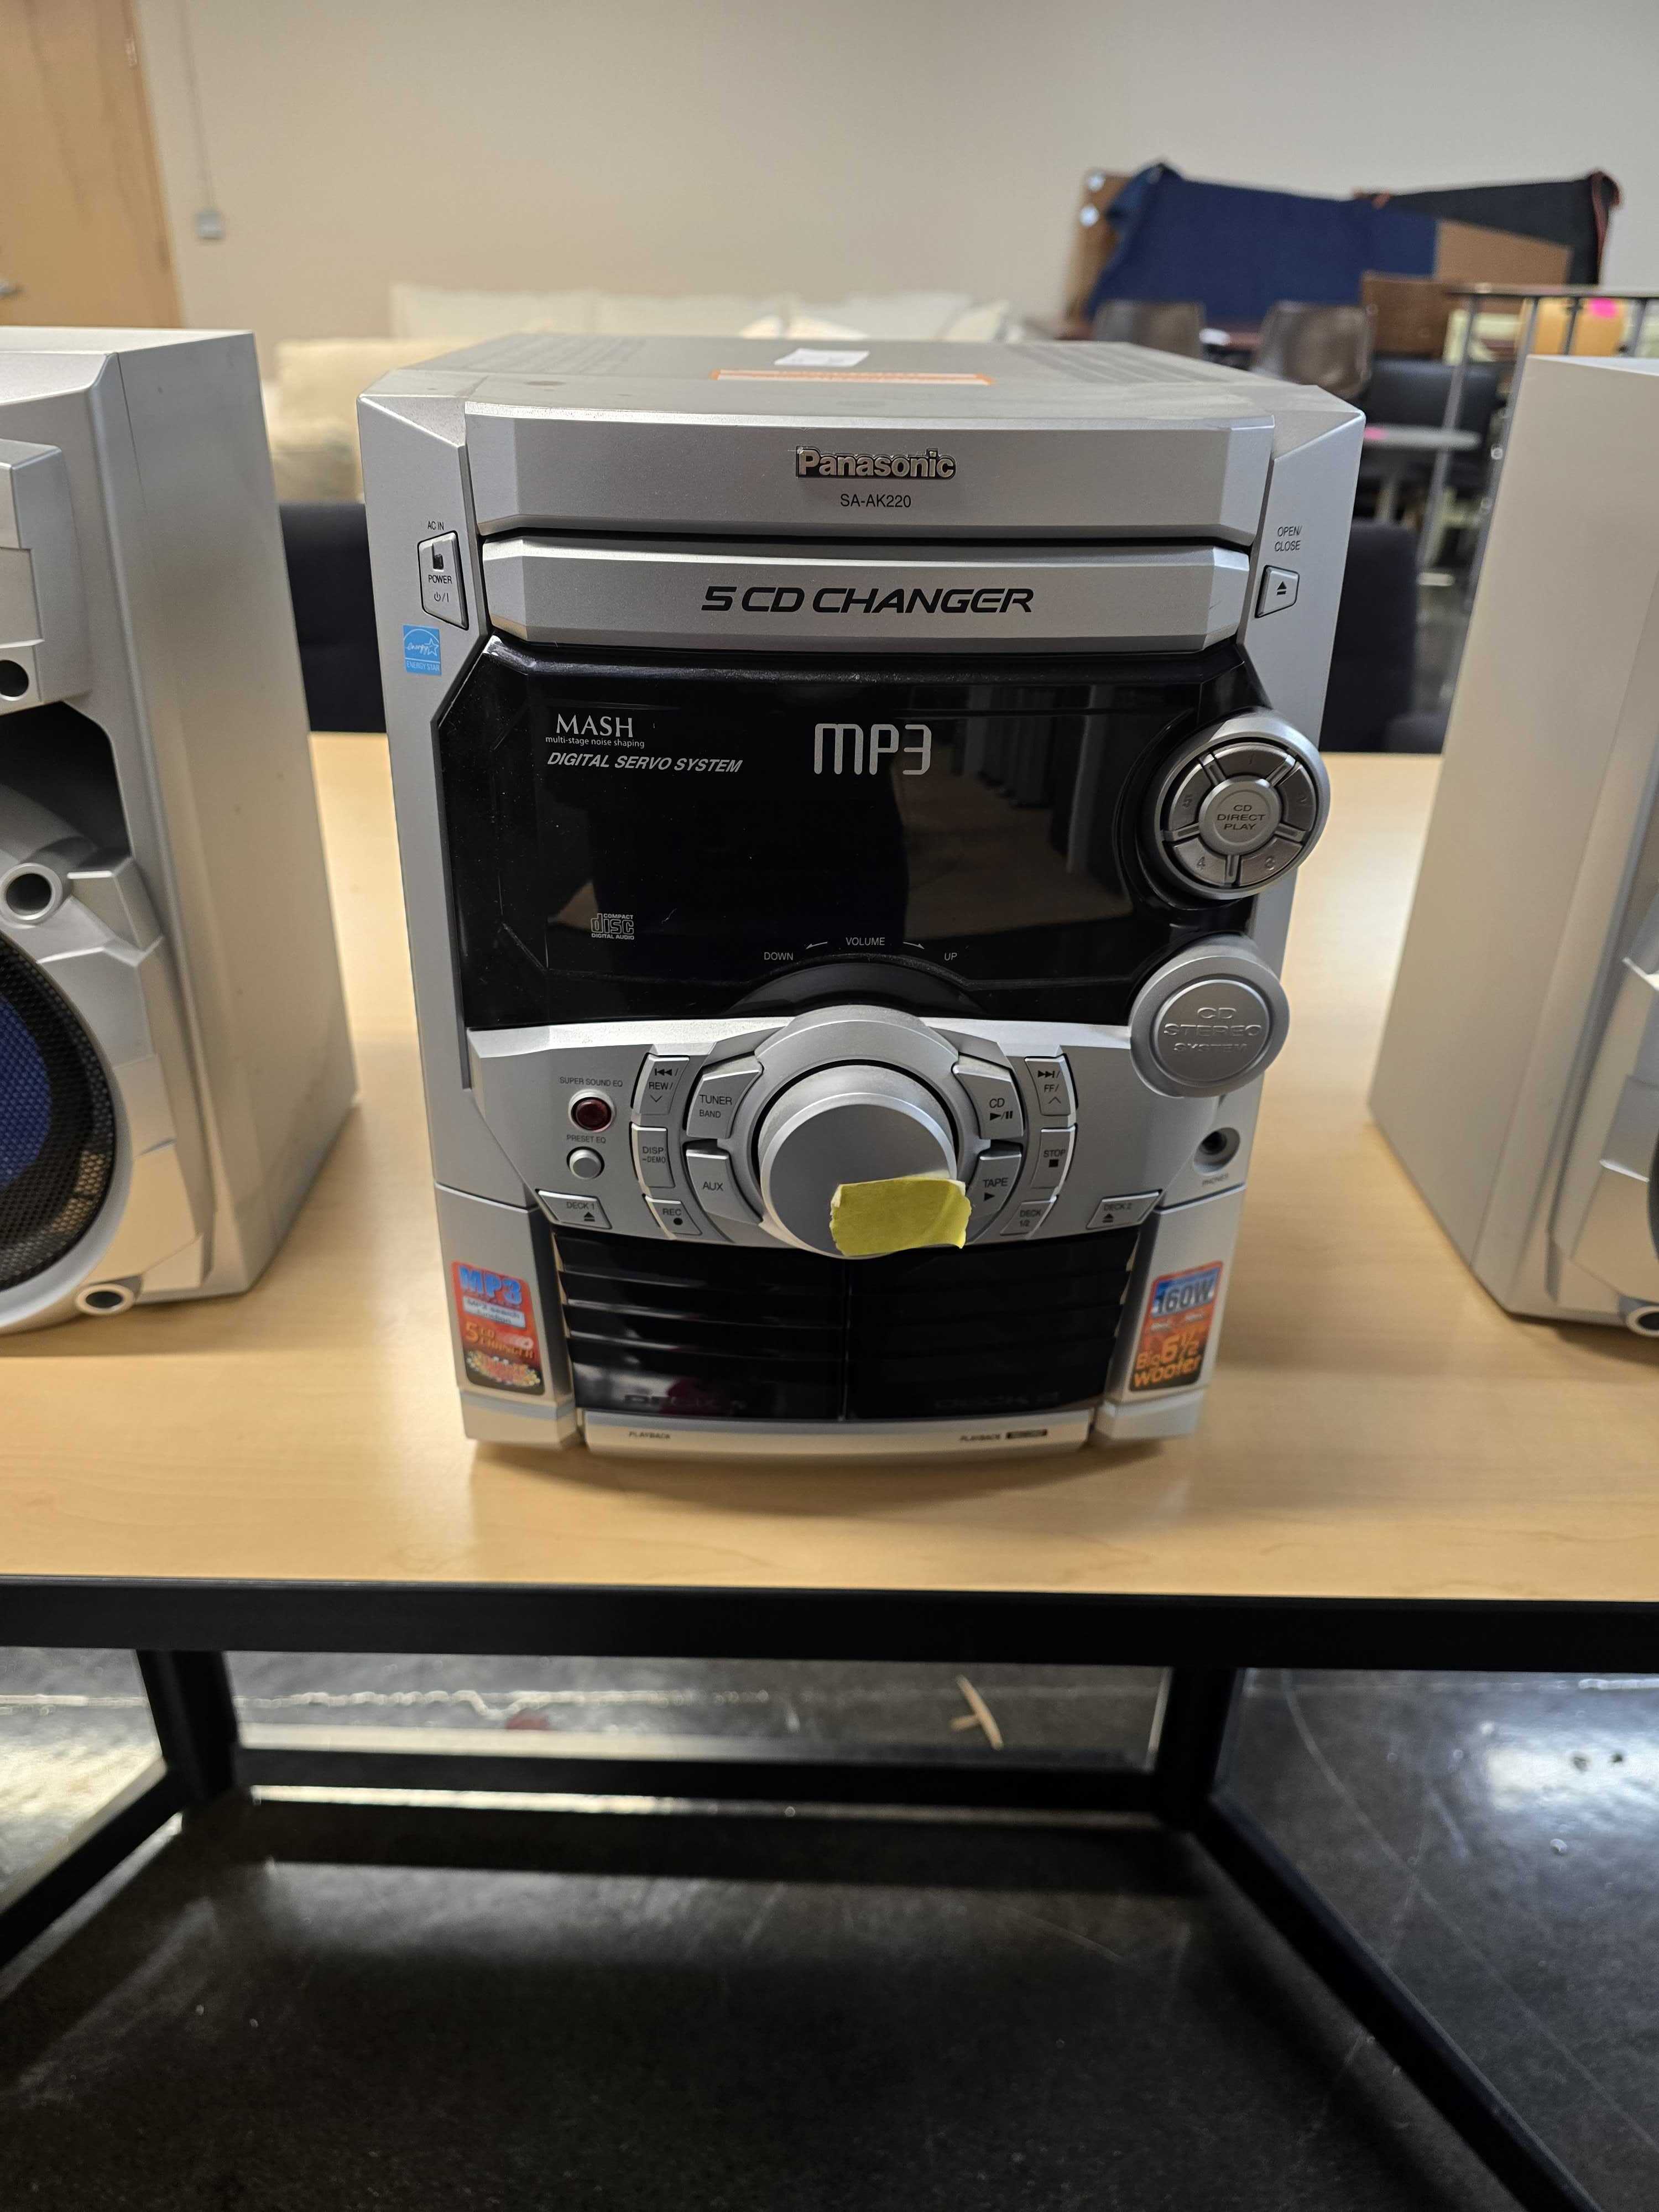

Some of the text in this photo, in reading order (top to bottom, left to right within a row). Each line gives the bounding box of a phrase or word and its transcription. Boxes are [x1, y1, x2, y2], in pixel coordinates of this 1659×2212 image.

[797, 447, 956, 479] Panasonic
[839, 493, 912, 508] SA-AK220
[427, 521, 444, 531] AC IN
[1275, 540, 1301, 552] CLOSE
[428, 575, 452, 584] POWER
[701, 586, 1034, 614] 5 CD CHANGER
[406, 661, 440, 671] ENERGY STAR
[556, 713, 634, 738] MASH
[545, 736, 645, 749] multi-stage noise shaping
[814, 723, 932, 775] MP3
[547, 752, 743, 773] DIGITAL SERVO SYSTEM
[846, 937, 885, 946] VOLUME
[764, 952, 794, 961] DOWN
[944, 952, 958, 961] UP
[1197, 1007, 1237, 1019] CD
[1164, 1023, 1262, 1037] STEREO
[560, 1077, 623, 1088] SUPER SOUND EQ
[699, 1094, 733, 1105] TUNER
[989, 1097, 1005, 1108] CD
[699, 1109, 722, 1118] BAND
[566, 1134, 606, 1144] PRESET EQ
[642, 1146, 664, 1154] DISP
[1044, 1149, 1066, 1157] STOP
[702, 1181, 723, 1191] AUX
[983, 1177, 1009, 1188] TAPE
[566, 1202, 595, 1211] DECK 1
[662, 1208, 682, 1216] REC
[1103, 1202, 1133, 1212] DECK 2
[1020, 1219, 1030, 1227] 1/2
[458, 1264, 523, 1306] MP3
[1155, 1276, 1215, 1314] 160W
[465, 1321, 479, 1343] 5
